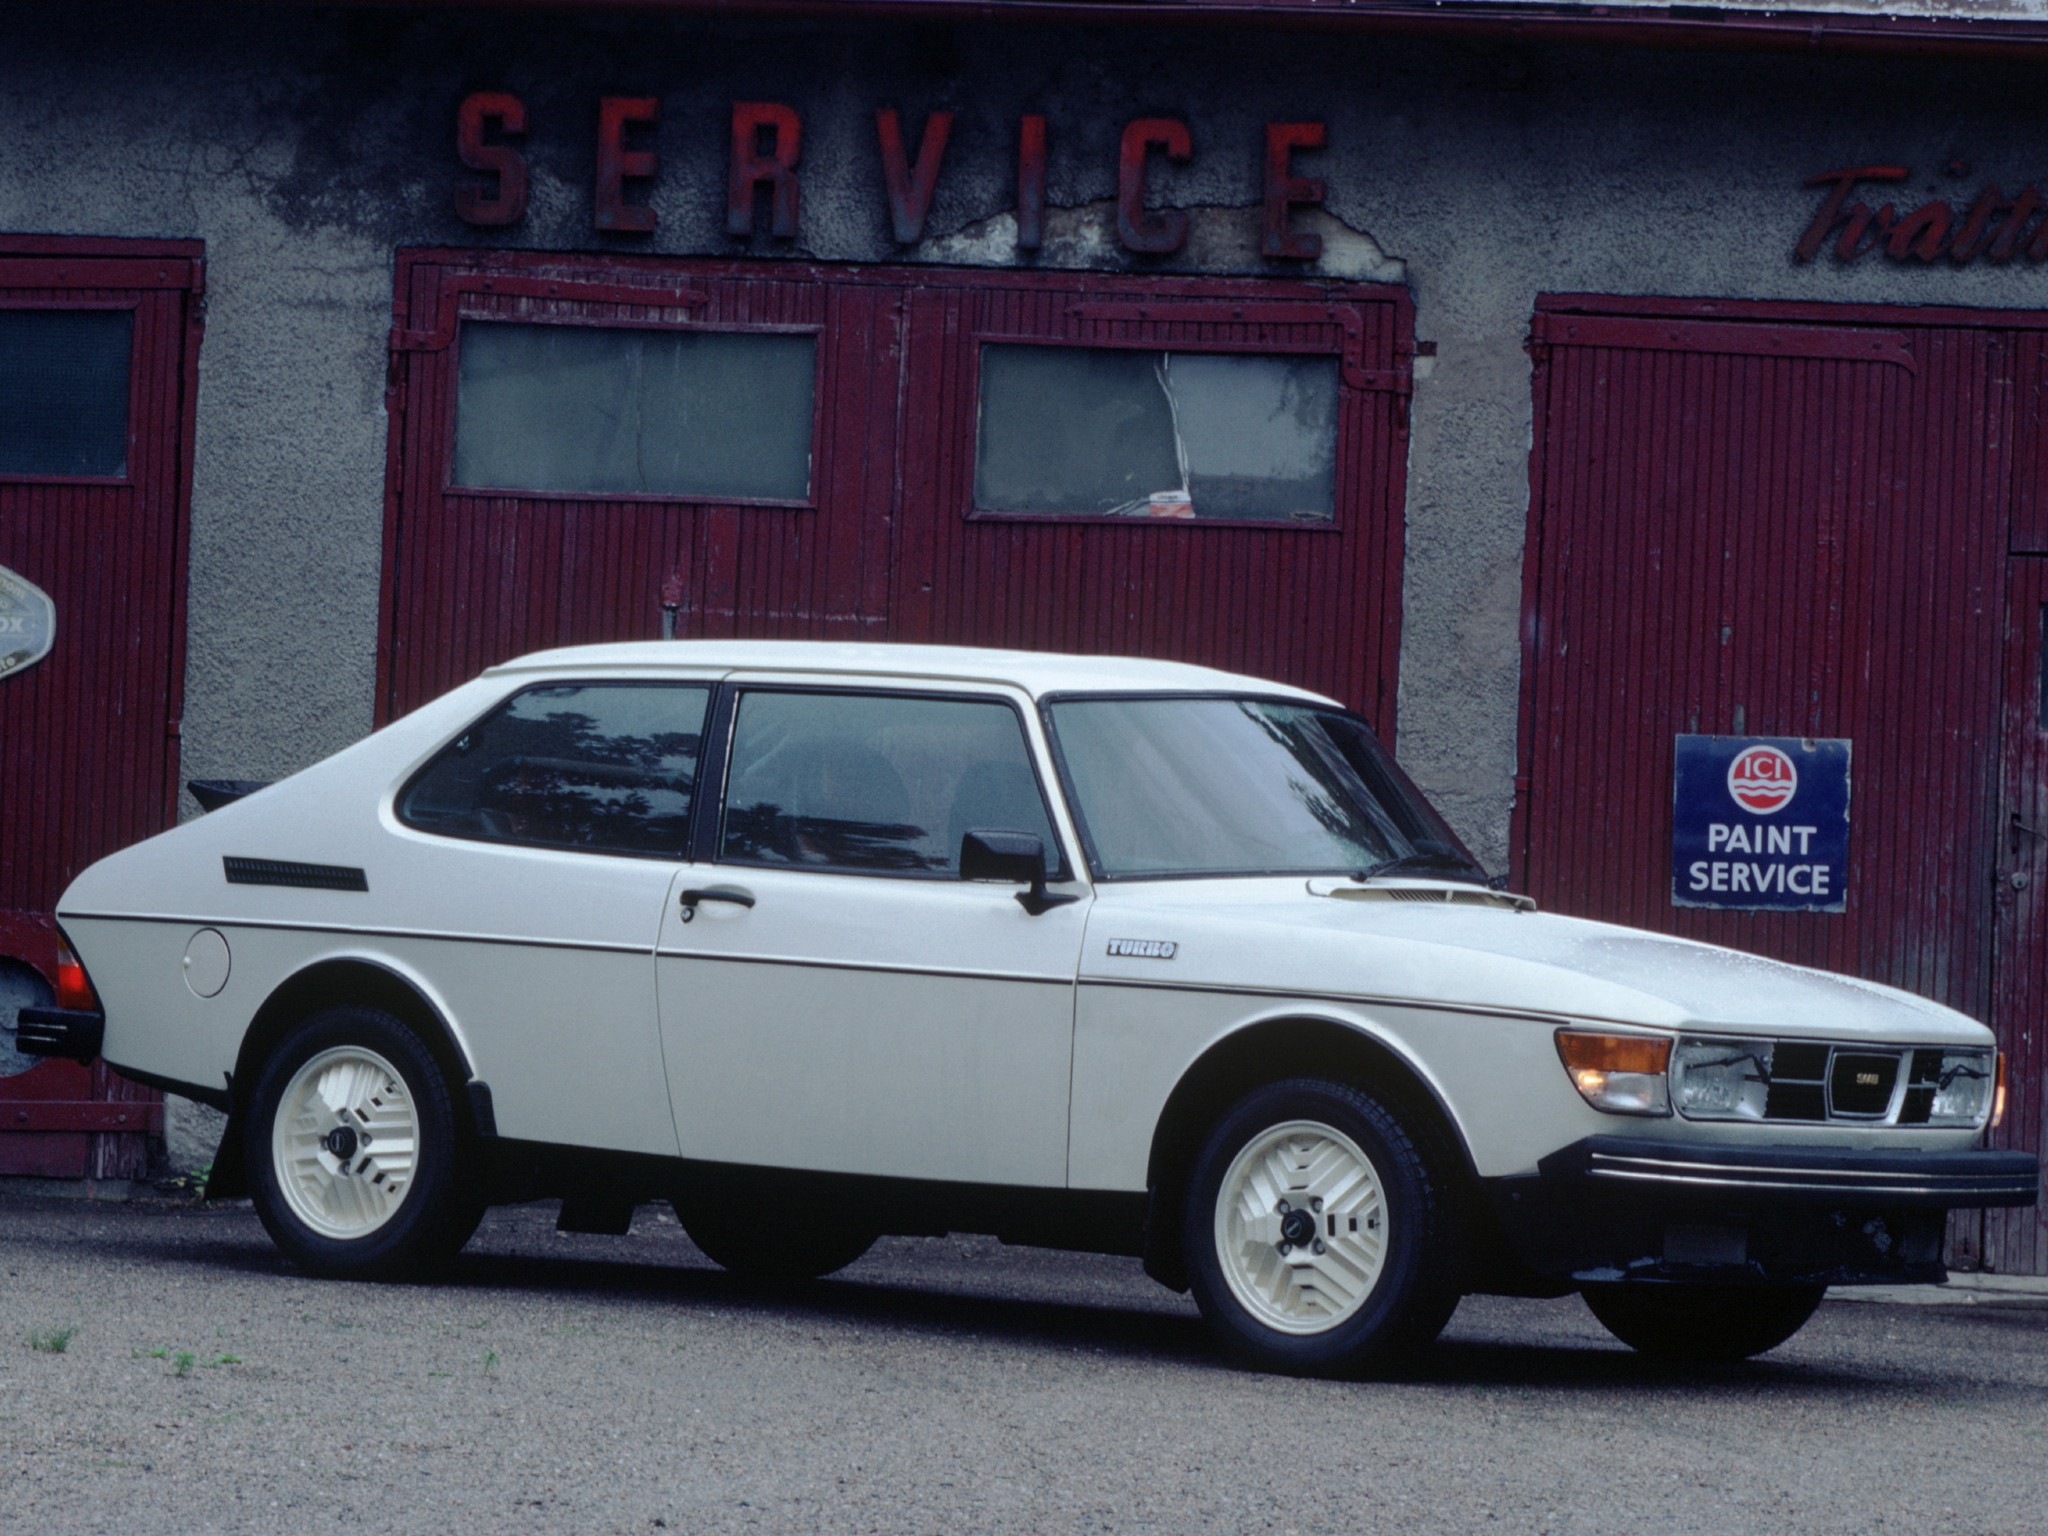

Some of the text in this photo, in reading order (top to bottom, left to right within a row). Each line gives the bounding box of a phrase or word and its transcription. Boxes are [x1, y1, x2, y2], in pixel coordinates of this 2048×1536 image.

[454, 91, 1328, 258] SERVICE
[1744, 757, 1782, 779] ICI
[1708, 823, 1818, 855] PAINT
[1689, 861, 1830, 895] SERVICE
[1107, 938, 1177, 960] TURBO
